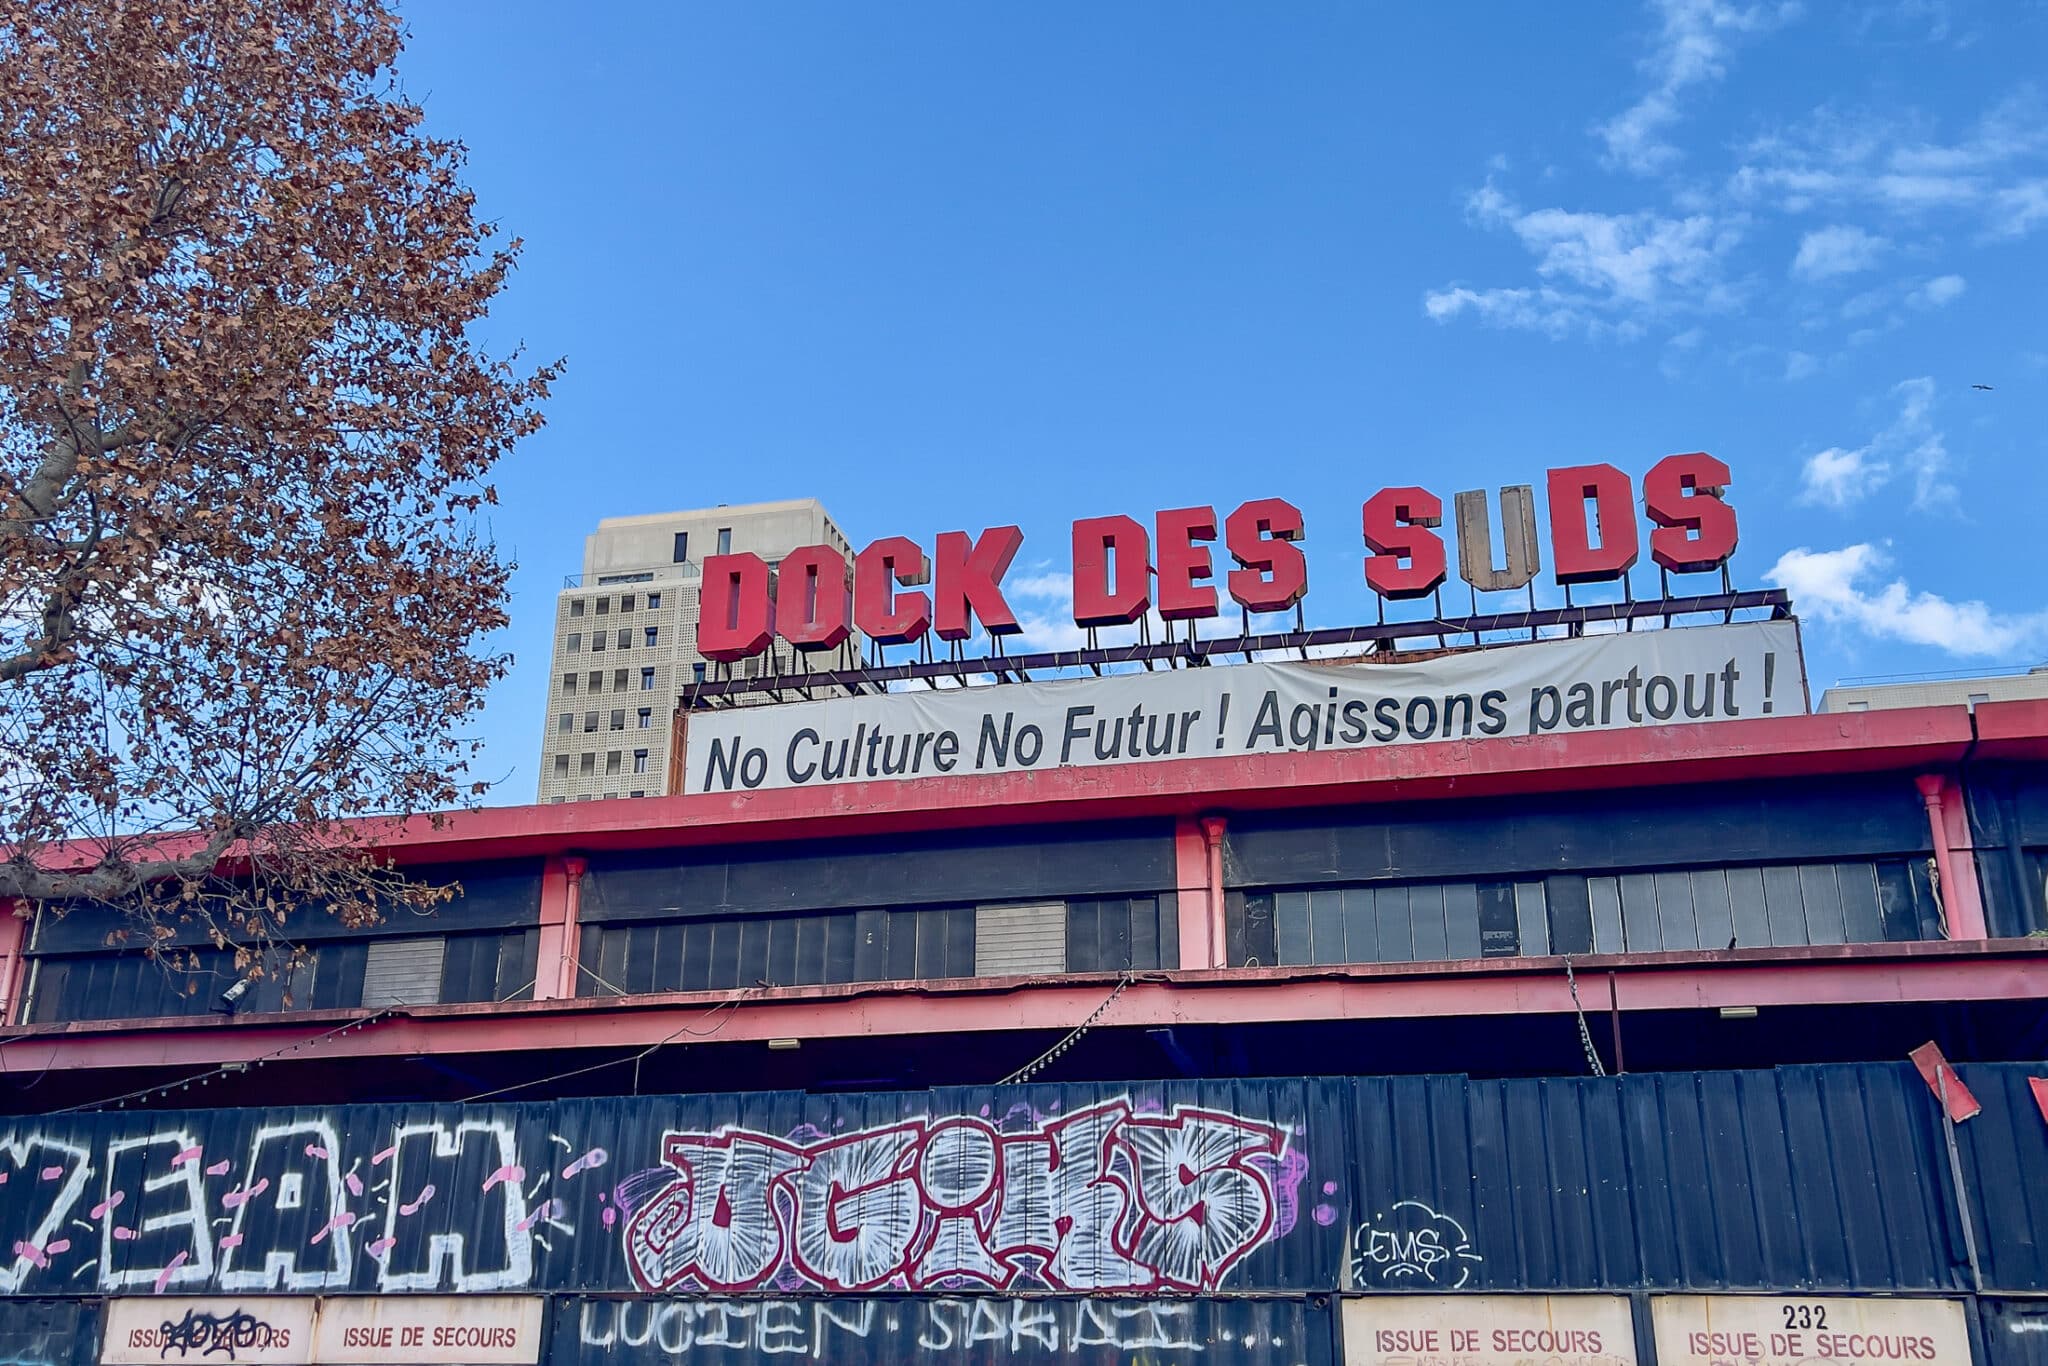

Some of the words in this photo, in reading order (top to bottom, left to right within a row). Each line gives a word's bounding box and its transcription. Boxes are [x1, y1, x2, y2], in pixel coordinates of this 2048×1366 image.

[697, 525, 1024, 662] DOCK
[1072, 498, 1308, 627] DES
[1363, 452, 1738, 600] SUDS
[703, 735, 767, 792] No
[787, 723, 959, 784] Culture
[976, 711, 1043, 768] No
[1060, 703, 1201, 763] Futur
[1246, 686, 1508, 752] Agissons
[1528, 657, 1741, 735] partout
[579, 1301, 874, 1358] LUCIEN
[1783, 1305, 1828, 1330] 232
[343, 1327, 393, 1347] ISSUE
[400, 1327, 425, 1347] DE
[432, 1327, 516, 1348] SECOURS
[1375, 1330, 1438, 1352] ISSUE
[1450, 1330, 1480, 1352] DE
[1492, 1330, 1602, 1353] SECOURS
[1688, 1332, 1758, 1356] ISSUE
[1771, 1333, 1804, 1357] DE
[1817, 1334, 1936, 1359] SECOURS
